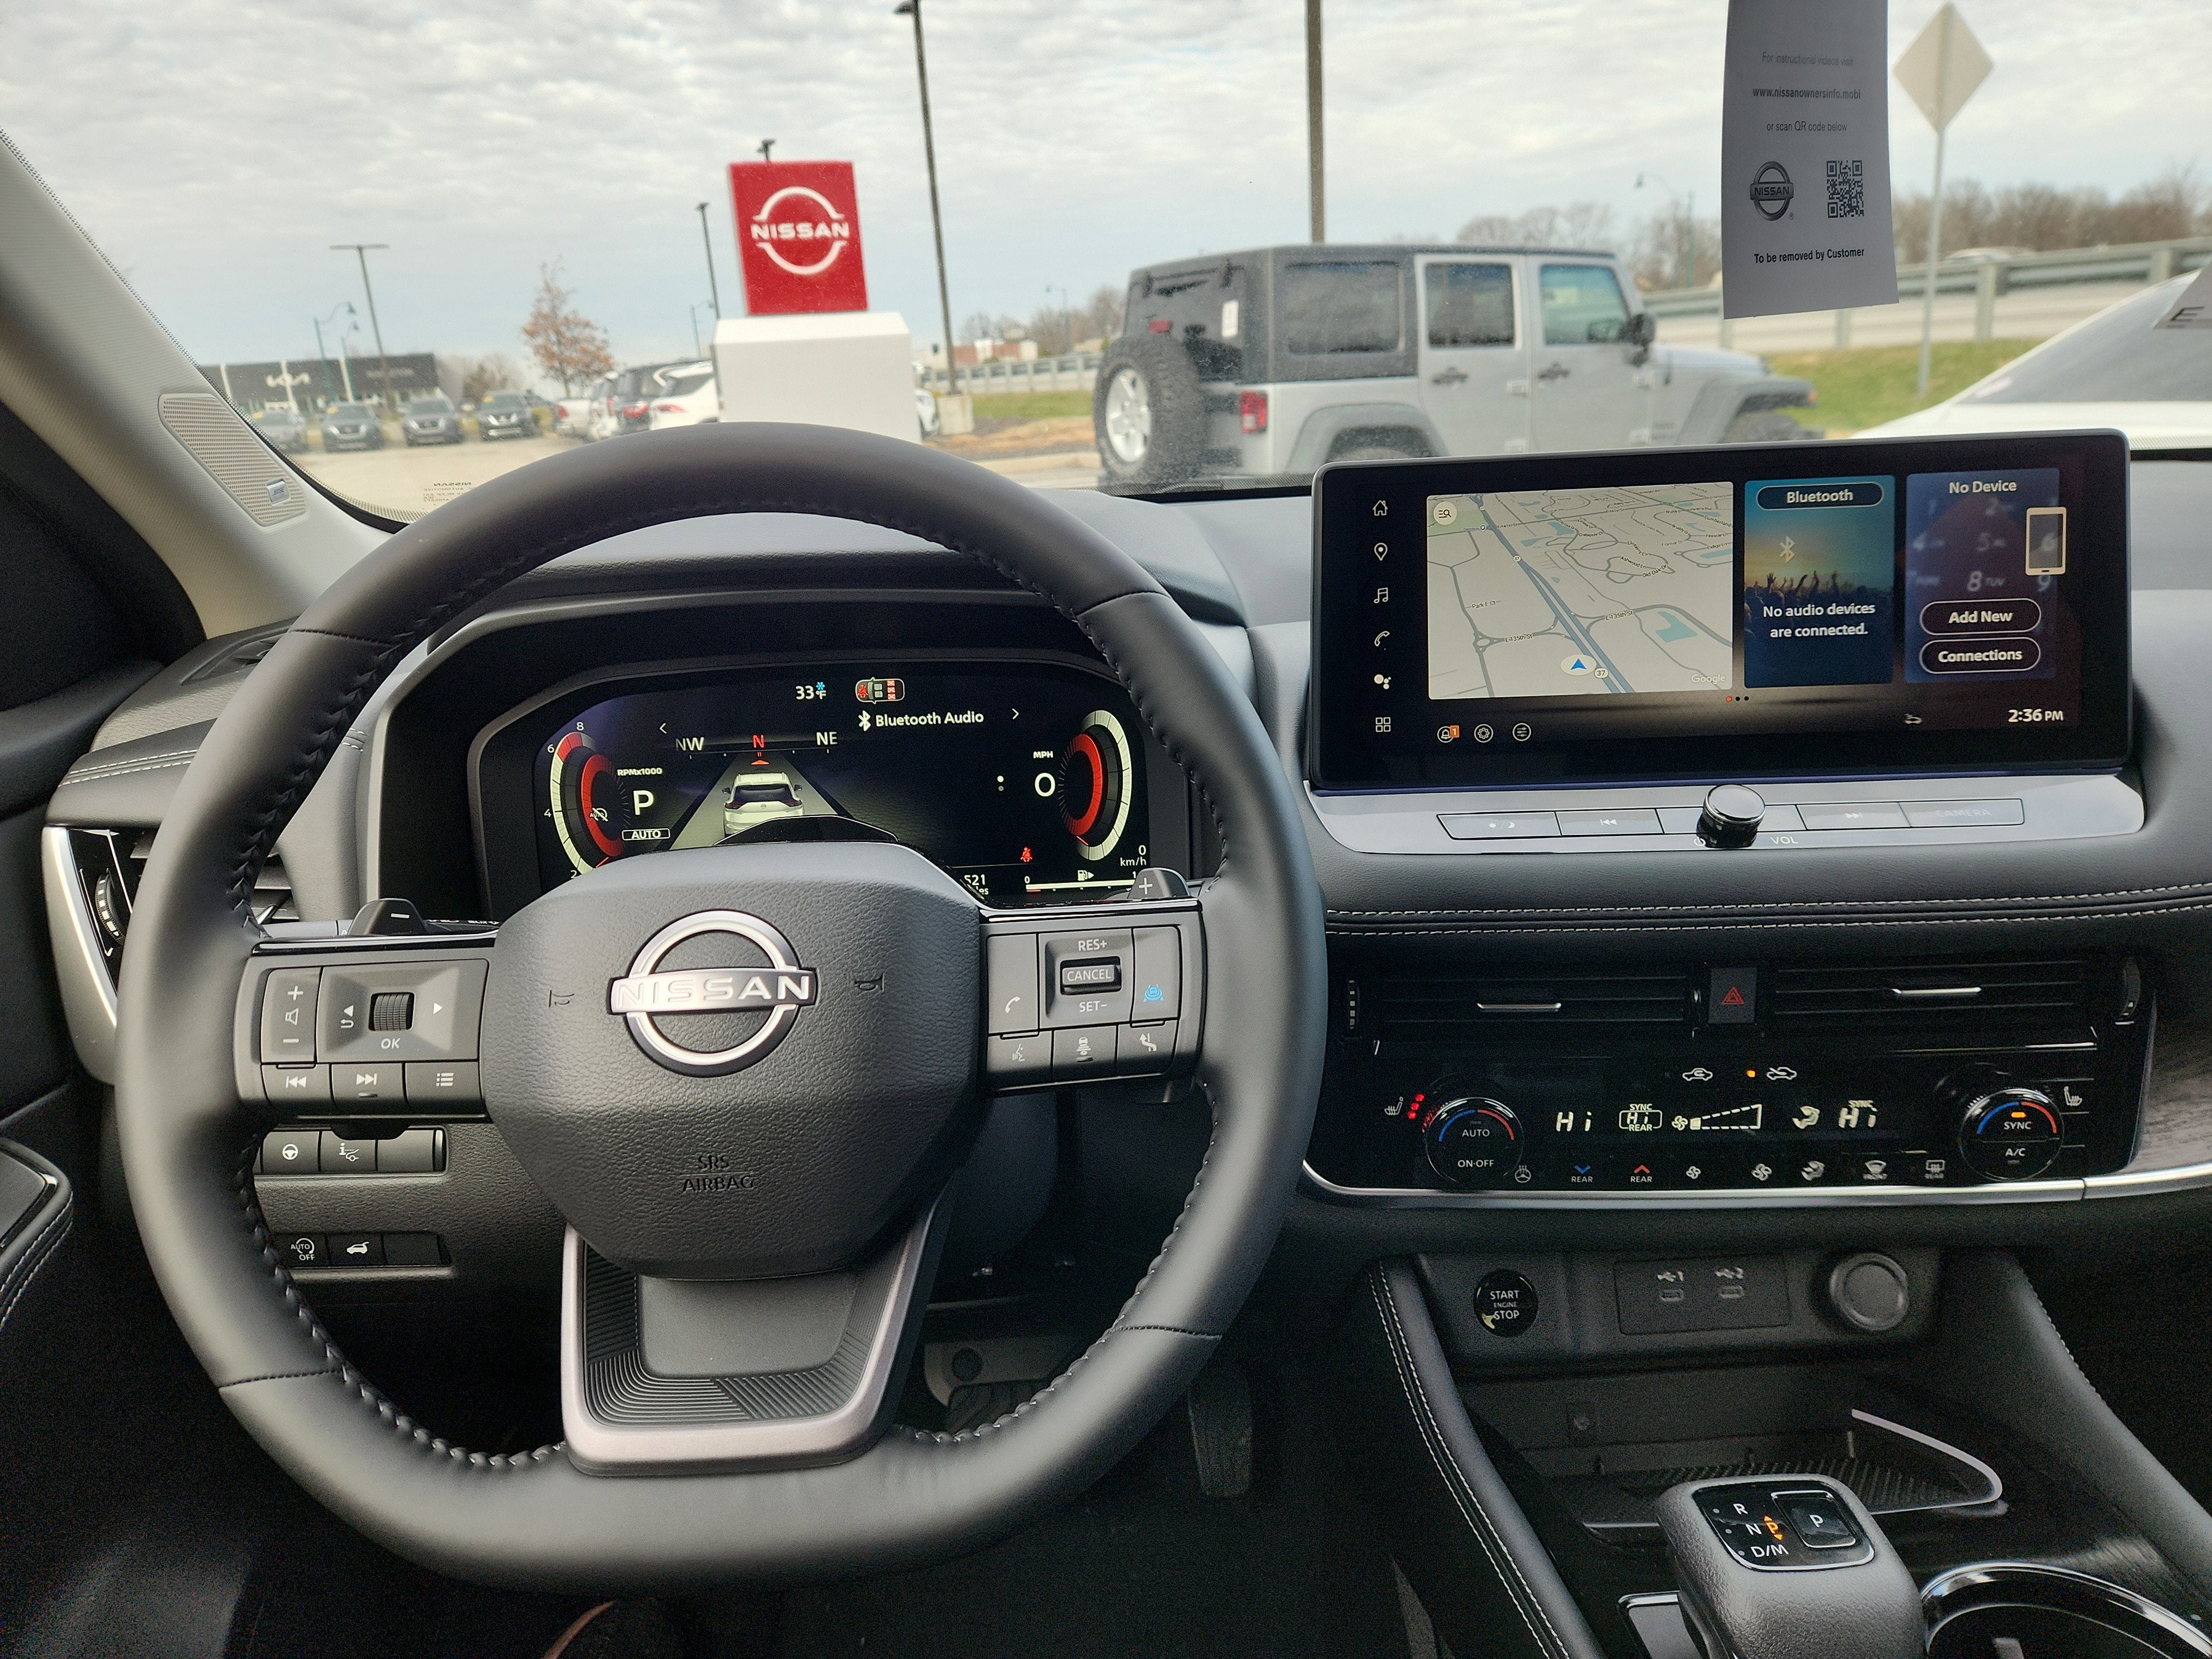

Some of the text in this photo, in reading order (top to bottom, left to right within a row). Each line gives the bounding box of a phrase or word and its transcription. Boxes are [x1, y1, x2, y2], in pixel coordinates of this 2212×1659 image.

[1762, 52, 1773, 63] For
[1775, 53, 1816, 65] instructional
[1818, 55, 1840, 66] videos
[1753, 87, 1861, 99] www.nissanownersinfo.mobi
[1766, 121, 1848, 131] or scan QR code below
[1754, 187, 1790, 196] NISSAN
[750, 221, 850, 240] NISSAN
[1754, 248, 1865, 263] To be removed by Customer
[1949, 480, 2017, 494] No Device
[1786, 490, 1854, 504] Bluetooth
[1704, 516, 1731, 527] Cumberland
[1620, 556, 1640, 568] Ashwood
[1967, 571, 1983, 592] 8
[1763, 602, 1876, 618] No audio devices
[1949, 609, 2013, 624] Add New
[1770, 623, 1869, 638] are connected.
[1938, 649, 2023, 663] Connections
[1691, 673, 1726, 684] Google
[876, 710, 984, 727] Bluetooth Audio
[2008, 708, 2064, 723] 2:36 PM
[576, 722, 584, 731] 8
[676, 736, 704, 751] NW
[752, 735, 765, 748] N
[816, 731, 838, 745] NE
[547, 744, 555, 753] 6
[1033, 751, 1054, 759] MPH
[617, 767, 663, 776] RPMx1000
[1034, 772, 1056, 798] 0
[633, 789, 654, 816] P
[544, 808, 552, 818] 4
[1935, 809, 1992, 817] CAMERA
[631, 829, 661, 839] AUTO
[1770, 835, 1799, 845] VOL
[1138, 845, 1147, 856] 0
[1120, 857, 1147, 866] km/h
[570, 870, 577, 878] 2
[1024, 876, 1030, 884] 0
[1078, 938, 1108, 951] RES+
[1066, 968, 1112, 982] CANCEL
[616, 975, 809, 1008] NISSAN
[380, 1037, 401, 1050] OK
[1555, 1111, 1592, 1132] Hi
[1626, 1111, 1649, 1124] Hi
[1629, 1124, 1653, 1132] REAR
[2003, 1121, 2031, 1130] SYNC
[1462, 1128, 1490, 1137] AUTO
[2005, 1147, 2025, 1157] A/C
[697, 1154, 730, 1170] SRS
[681, 1175, 755, 1193] AIRBAG
[299, 1253, 315, 1262] OFF
[1490, 1290, 1520, 1300] START
[1493, 1310, 1520, 1320] STOP
[1733, 1503, 1748, 1515] R
[1809, 1514, 1824, 1528] P
[1745, 1523, 1762, 1535] N
[1766, 1522, 1779, 1534] P
[1750, 1544, 1789, 1558] D/M
